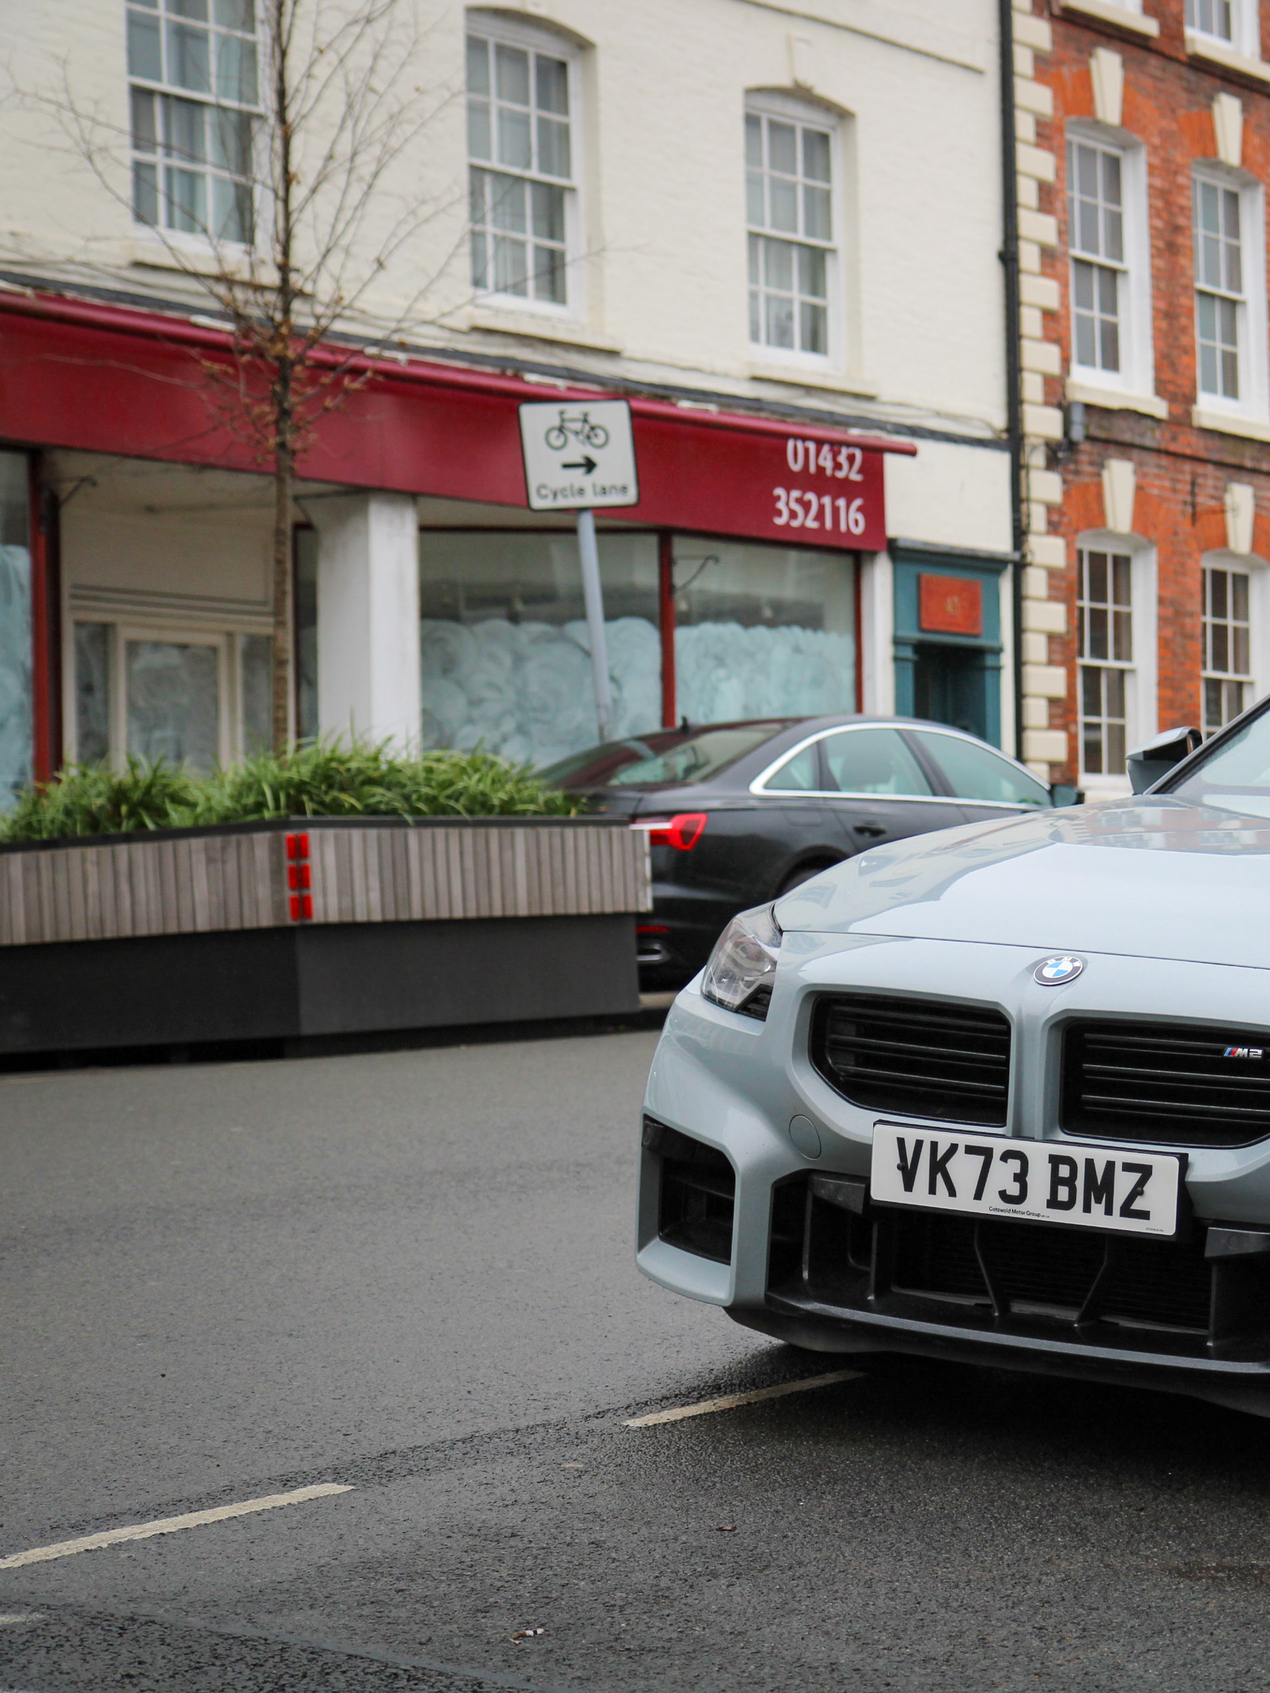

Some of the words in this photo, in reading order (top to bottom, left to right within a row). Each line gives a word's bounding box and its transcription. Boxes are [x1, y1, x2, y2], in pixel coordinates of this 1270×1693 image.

[786, 437, 864, 482] 01432
[536, 483, 586, 503] Cycle
[592, 482, 629, 498] lane
[772, 486, 866, 535] 352116
[896, 1137, 1029, 1204] VK73
[1046, 1153, 1153, 1220] BMZ
[988, 1206, 1011, 1214] Cotswold
[1026, 1210, 1042, 1218] Group
